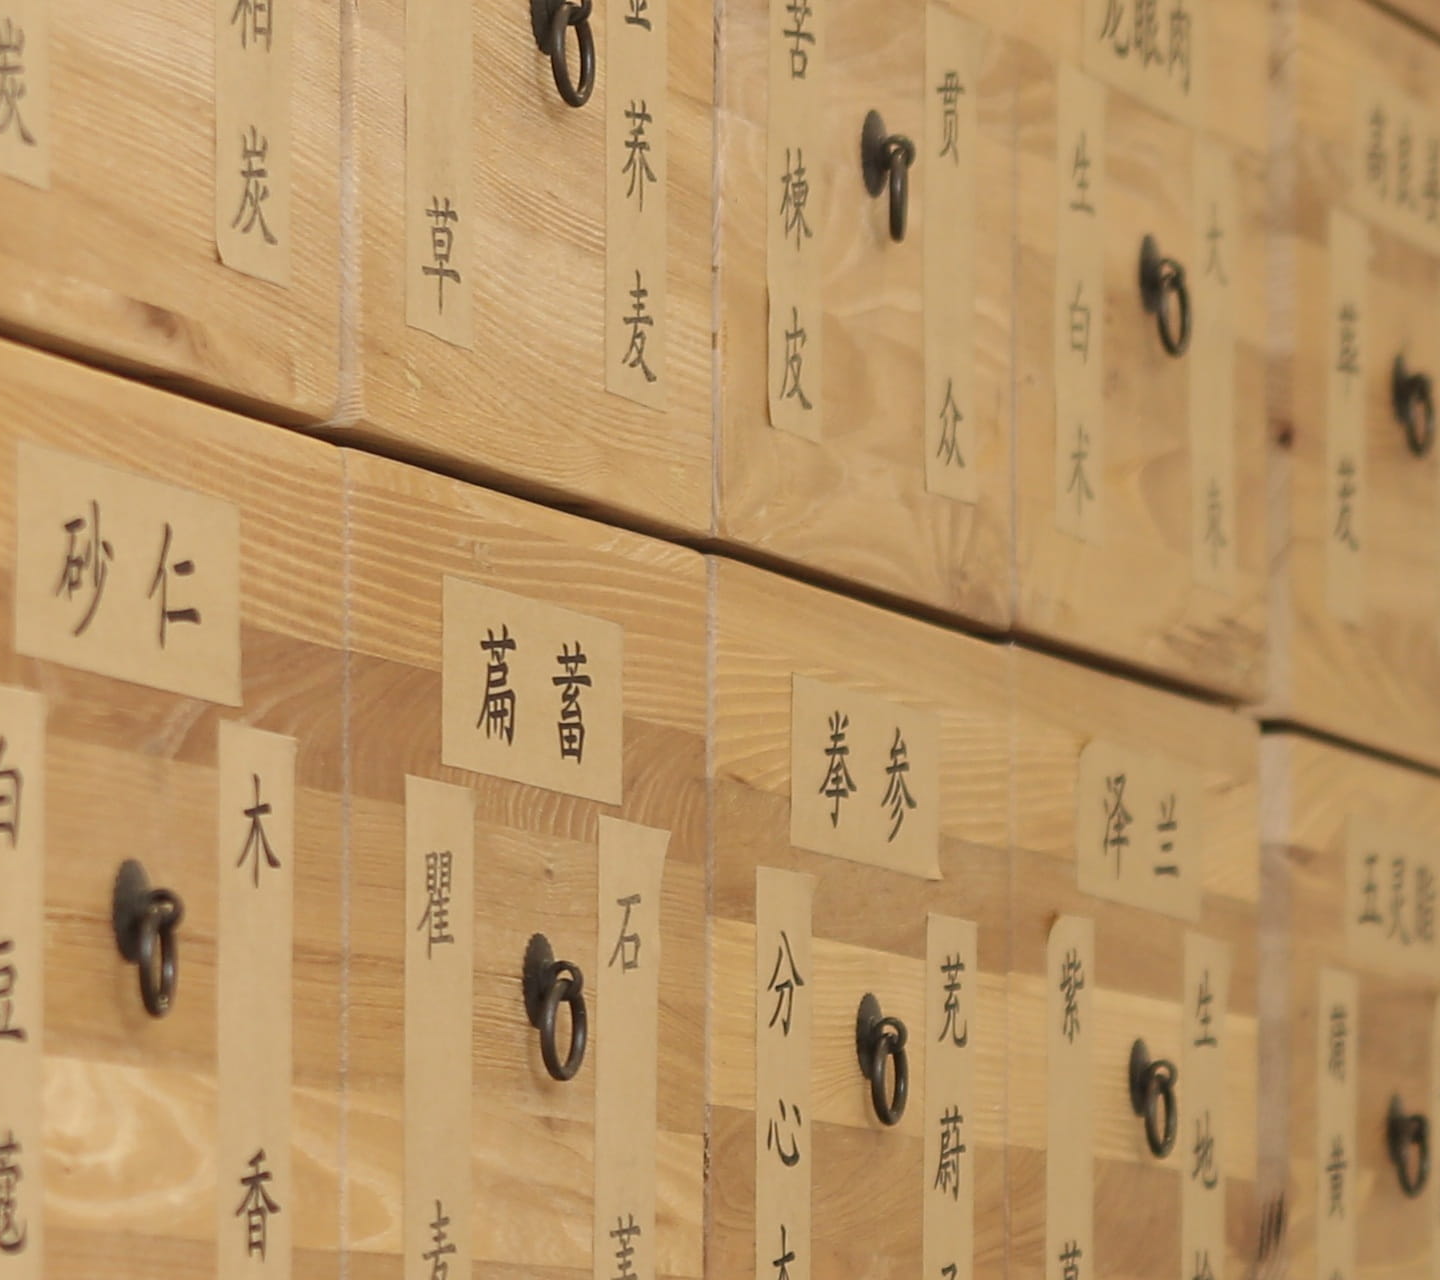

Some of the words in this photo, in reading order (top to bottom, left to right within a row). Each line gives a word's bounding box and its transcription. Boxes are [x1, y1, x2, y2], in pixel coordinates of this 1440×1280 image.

[422, 196, 461, 314] 草
[622, 0, 657, 382] 荞麦
[936, 71, 965, 468] 贯众
[56, 501, 201, 647] 砂仁
[477, 625, 592, 763] 萹蓄
[819, 711, 916, 842] 拳参
[1103, 774, 1179, 877] 泽兰
[235, 774, 280, 1260] 木香
